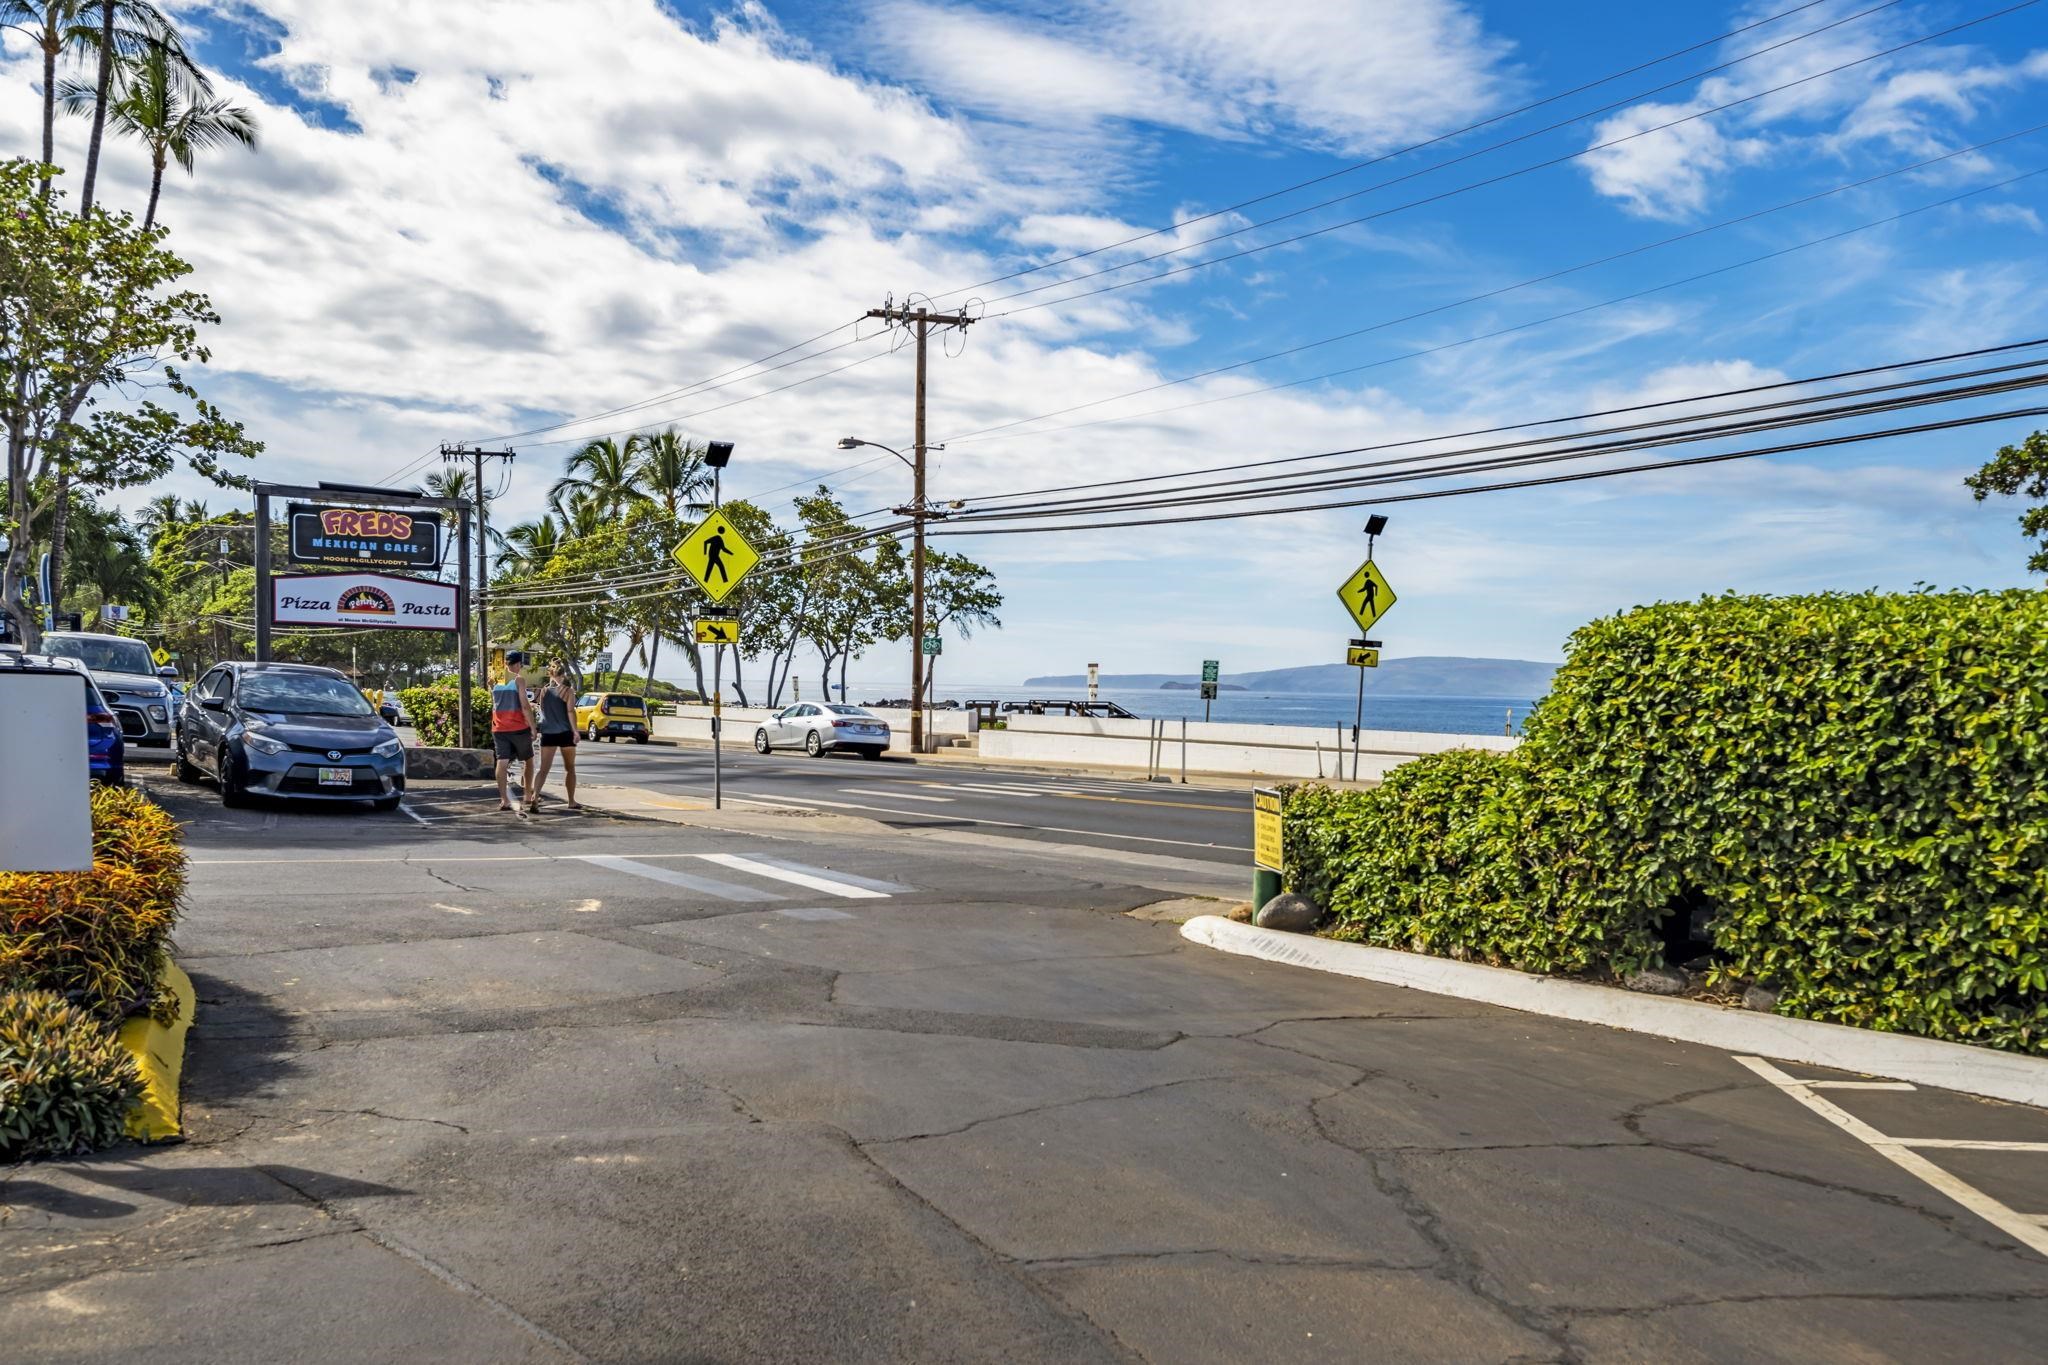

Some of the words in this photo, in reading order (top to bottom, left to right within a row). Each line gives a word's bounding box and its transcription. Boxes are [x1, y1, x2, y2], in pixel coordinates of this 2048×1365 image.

[321, 509, 412, 539] FRED'S
[312, 538, 377, 550] MEXICAN
[384, 543, 418, 553] CAFE
[280, 596, 332, 611] Pizza
[348, 596, 385, 610] Penny's
[402, 602, 451, 616] Pasta
[598, 662, 611, 671] 30
